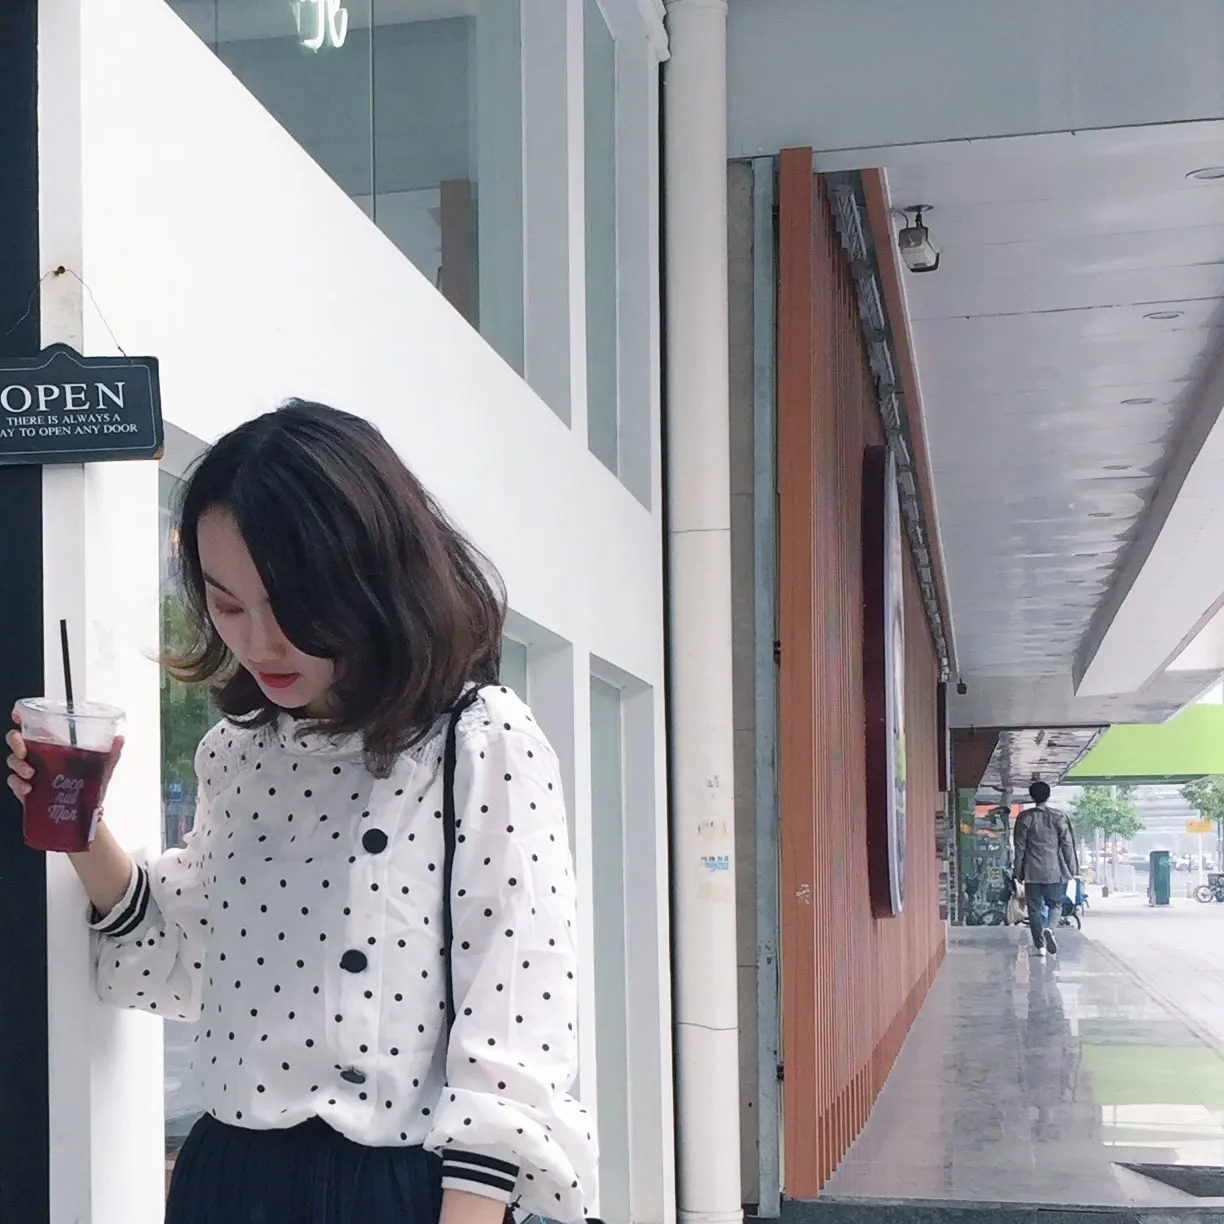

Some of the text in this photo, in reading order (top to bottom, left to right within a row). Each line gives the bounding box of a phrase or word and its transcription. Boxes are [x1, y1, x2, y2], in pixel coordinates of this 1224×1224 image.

[0, 381, 126, 413] OPEN
[6, 413, 121, 426] THERE IS ALWAYS A
[19, 427, 36, 437] TO
[39, 426, 71, 436] OPEN
[74, 424, 101, 435] ANY
[104, 423, 138, 434] DOOR
